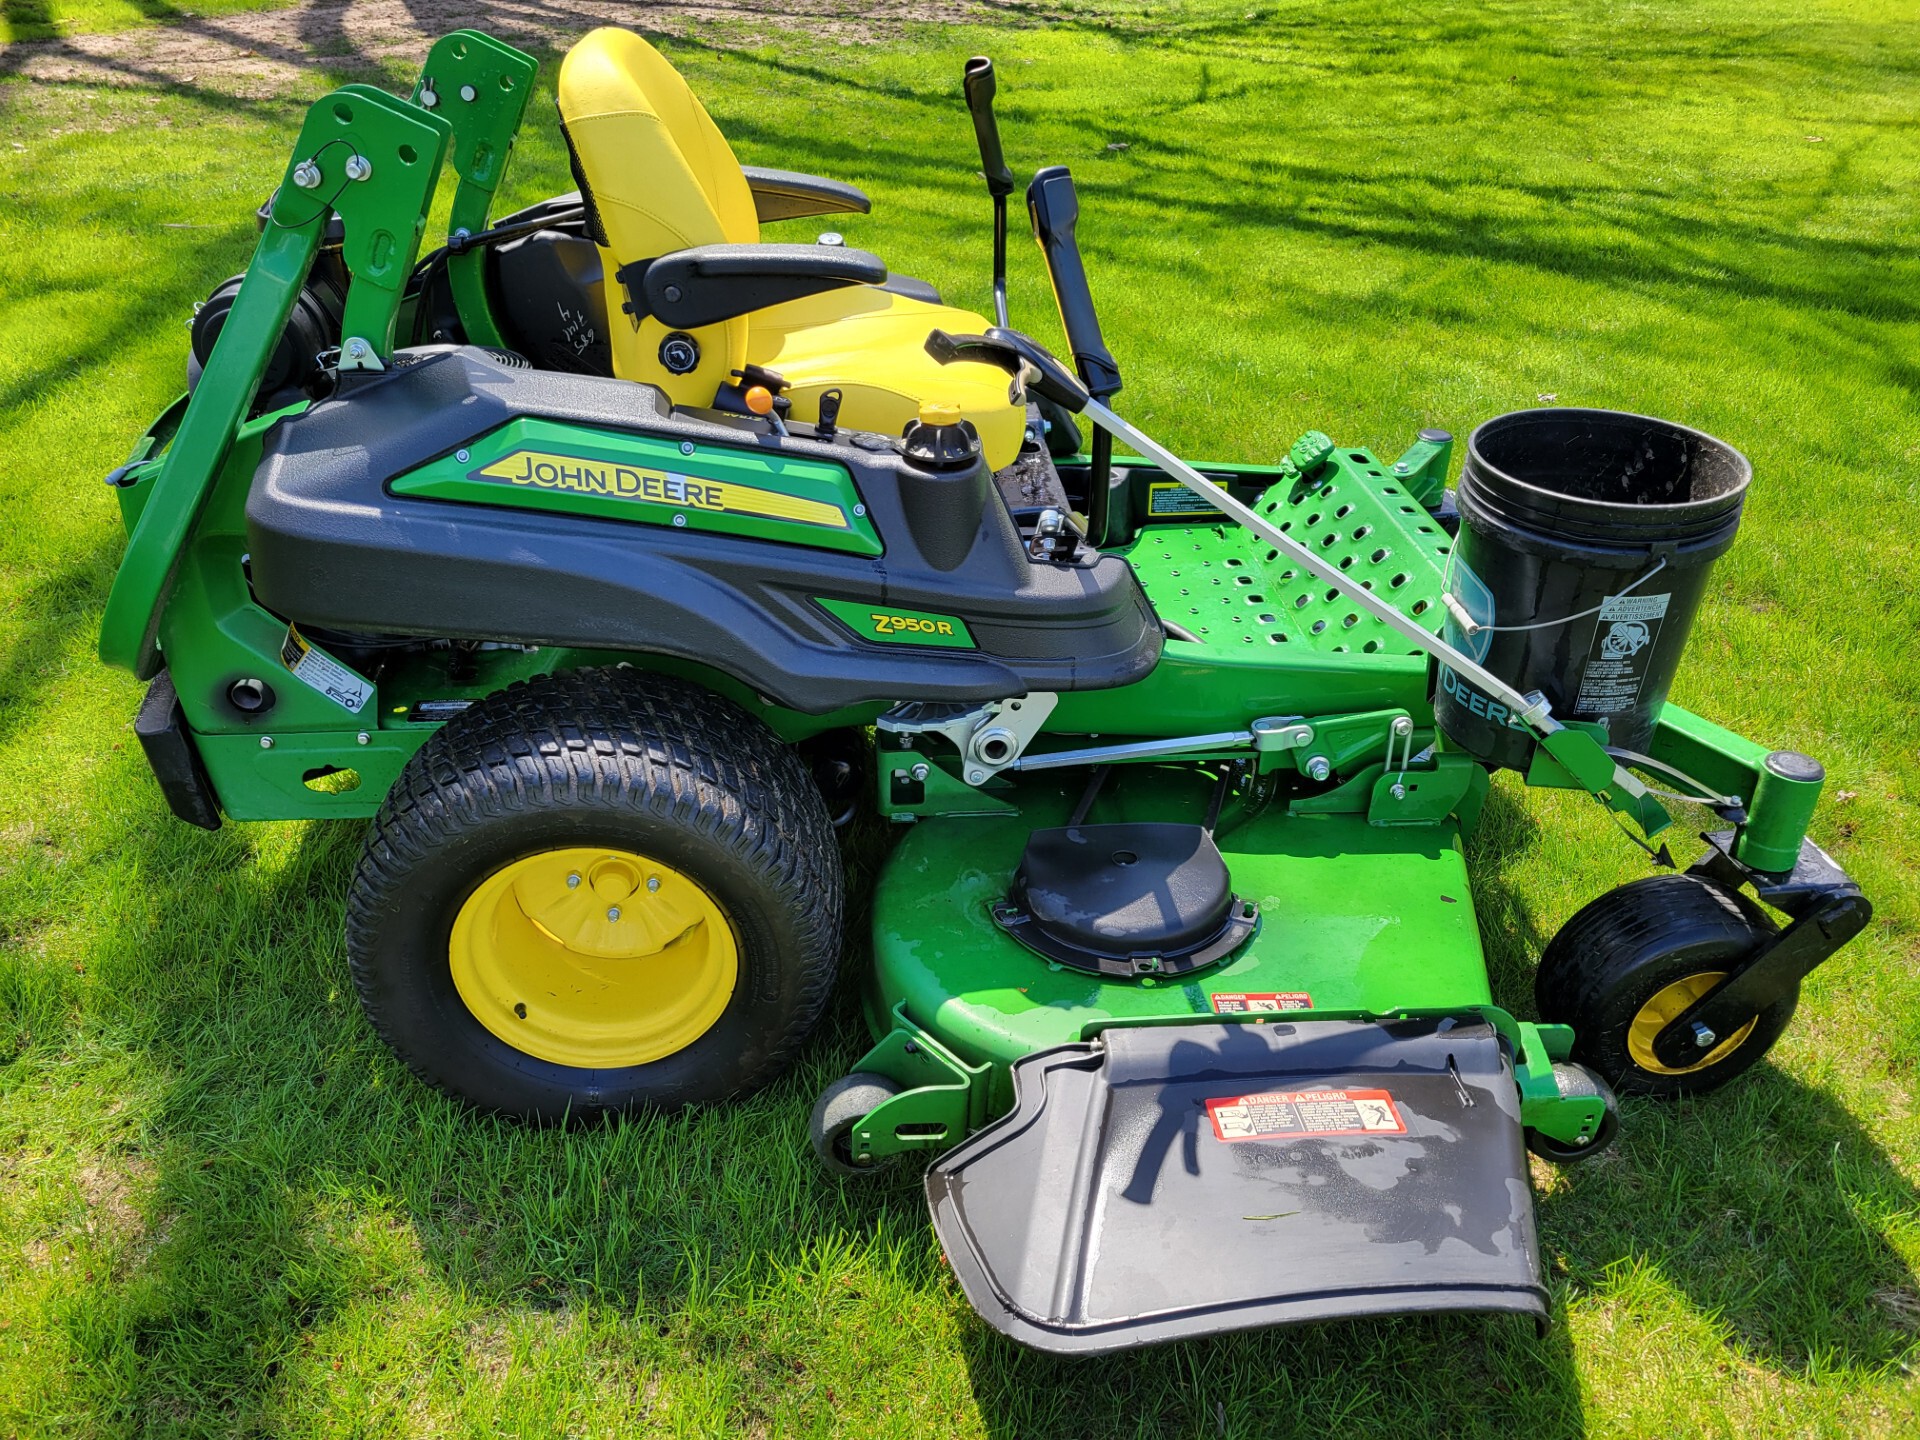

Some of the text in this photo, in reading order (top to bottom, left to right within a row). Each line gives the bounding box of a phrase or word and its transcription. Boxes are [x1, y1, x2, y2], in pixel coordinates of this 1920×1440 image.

[516, 456, 724, 508] JOHN DEERE
[1625, 597, 1658, 605] WARNING
[1617, 604, 1662, 612] ADVERTENCIA
[1610, 611, 1664, 620] AVERTISSEMENT
[871, 614, 954, 635] Z950R
[1249, 1092, 1347, 1105] DANGER PELIGRO
